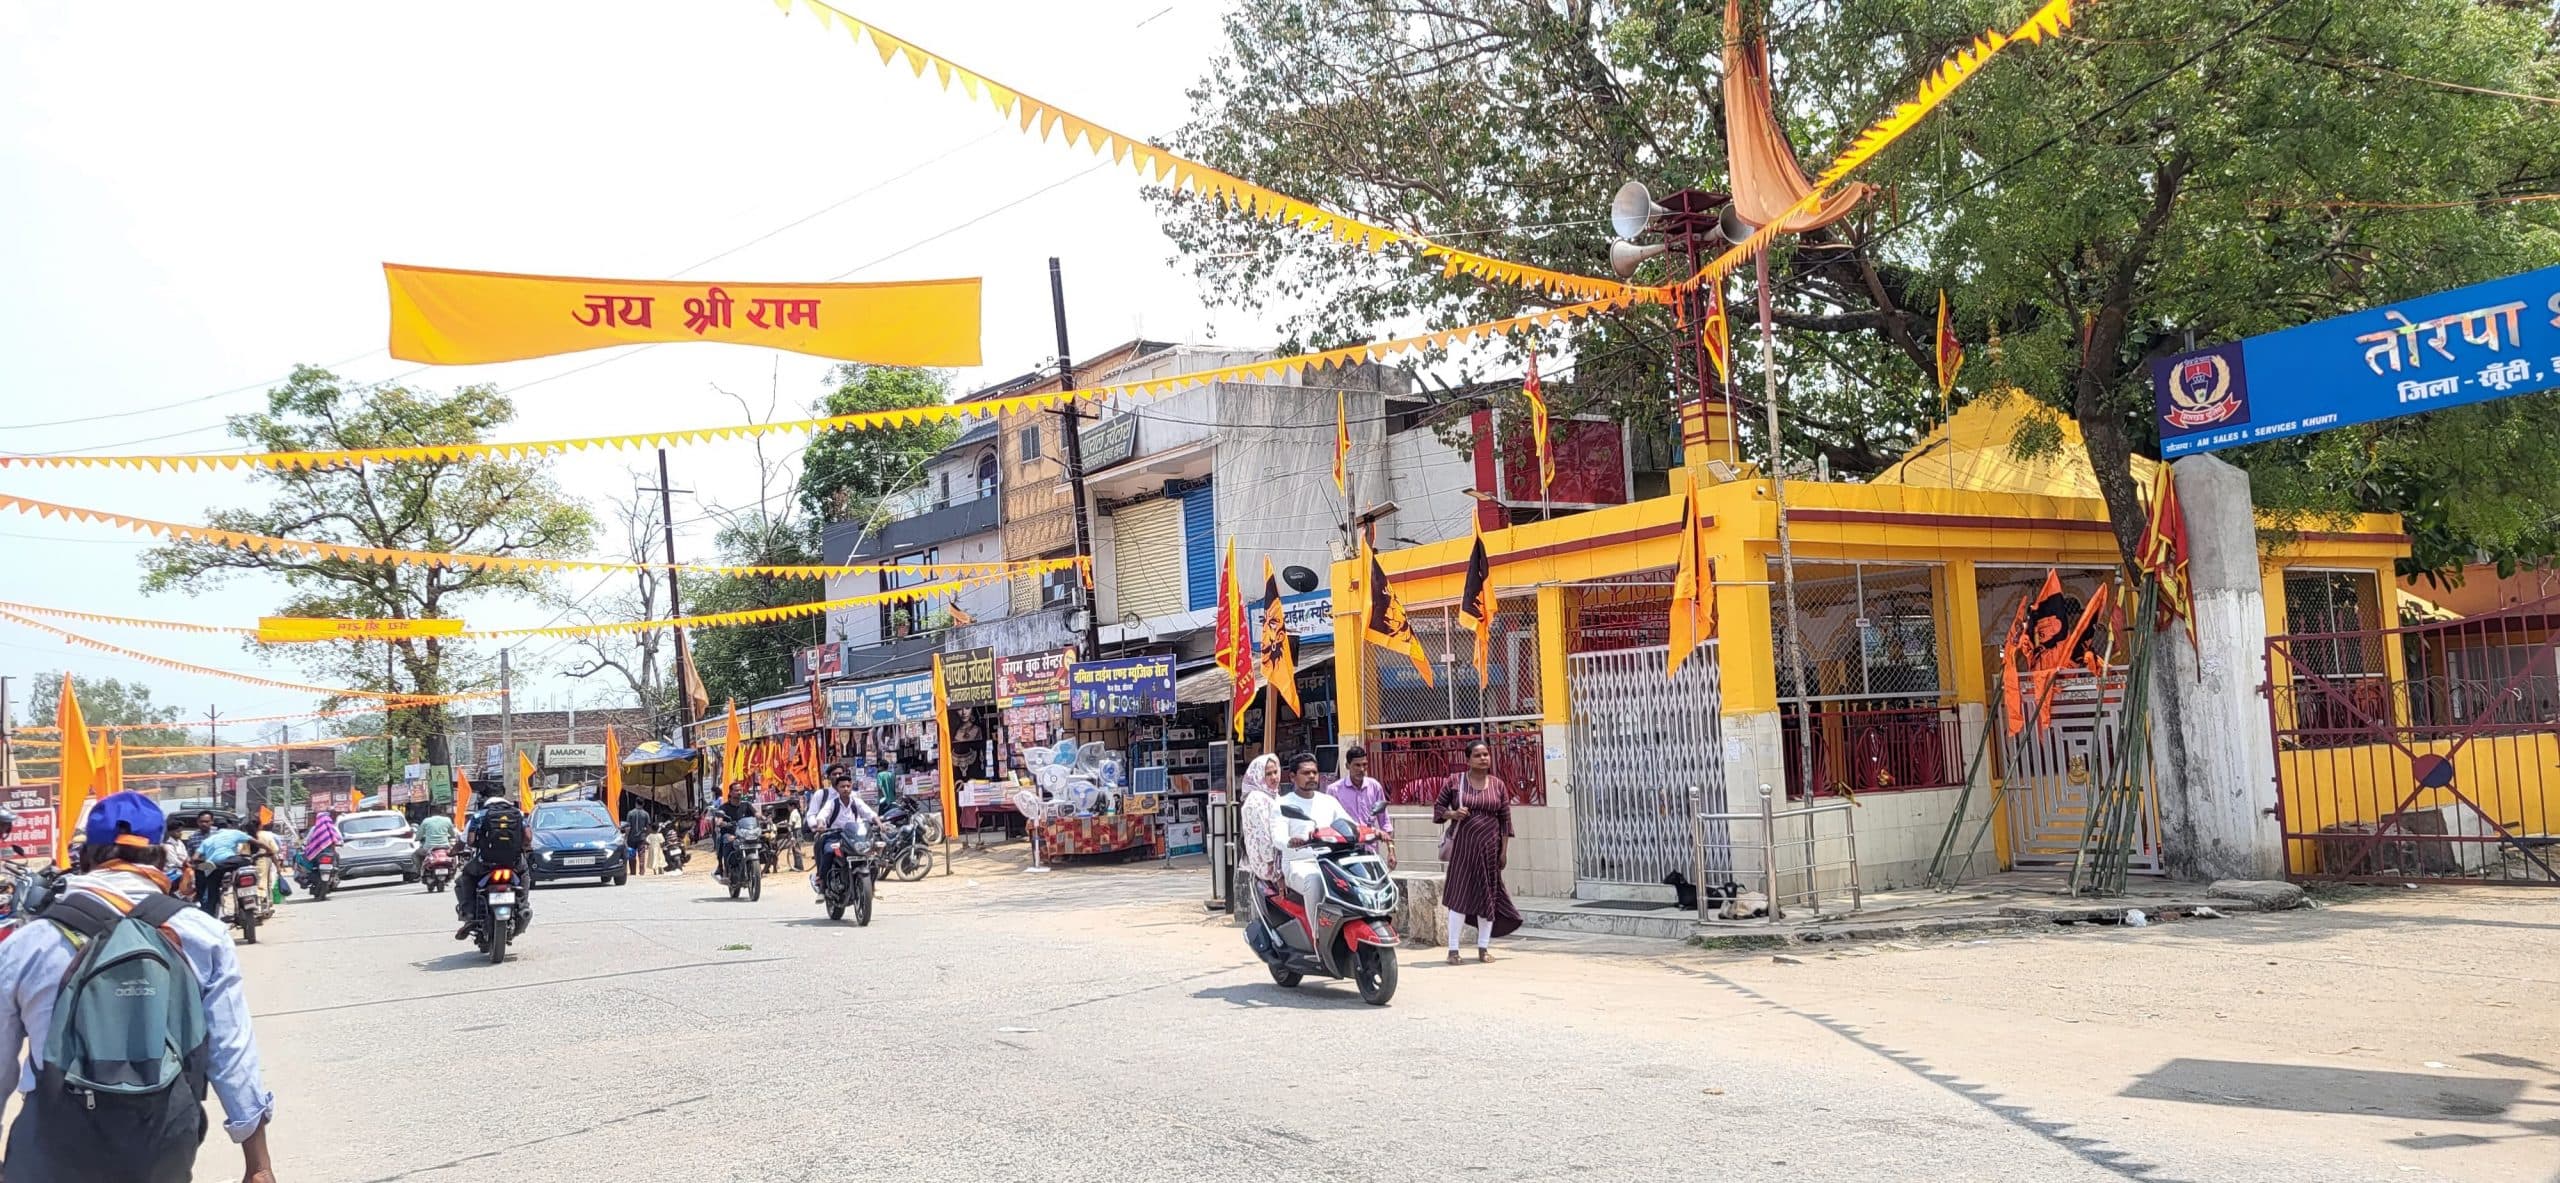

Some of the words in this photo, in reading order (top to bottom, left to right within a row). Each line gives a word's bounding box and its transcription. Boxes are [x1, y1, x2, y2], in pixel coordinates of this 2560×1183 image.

[572, 294, 655, 329] जय
[683, 287, 734, 335] श्री
[746, 298, 821, 330] राम
[2355, 300, 2529, 376] तोरपा
[2397, 376, 2460, 403] जिला
[2477, 358, 2531, 390] खूँटी
[2197, 437, 2210, 447] AM
[2213, 432, 2239, 444] SALES
[2242, 431, 2249, 439] &
[2255, 421, 2297, 436] SERVICES
[2302, 414, 2338, 427] KHUNTI
[945, 661, 968, 686] पायल
[1001, 658, 1024, 676] संगम
[1025, 657, 1040, 678] बुक
[1041, 652, 1064, 670] सेन्टर
[549, 748, 586, 756] AMARON
